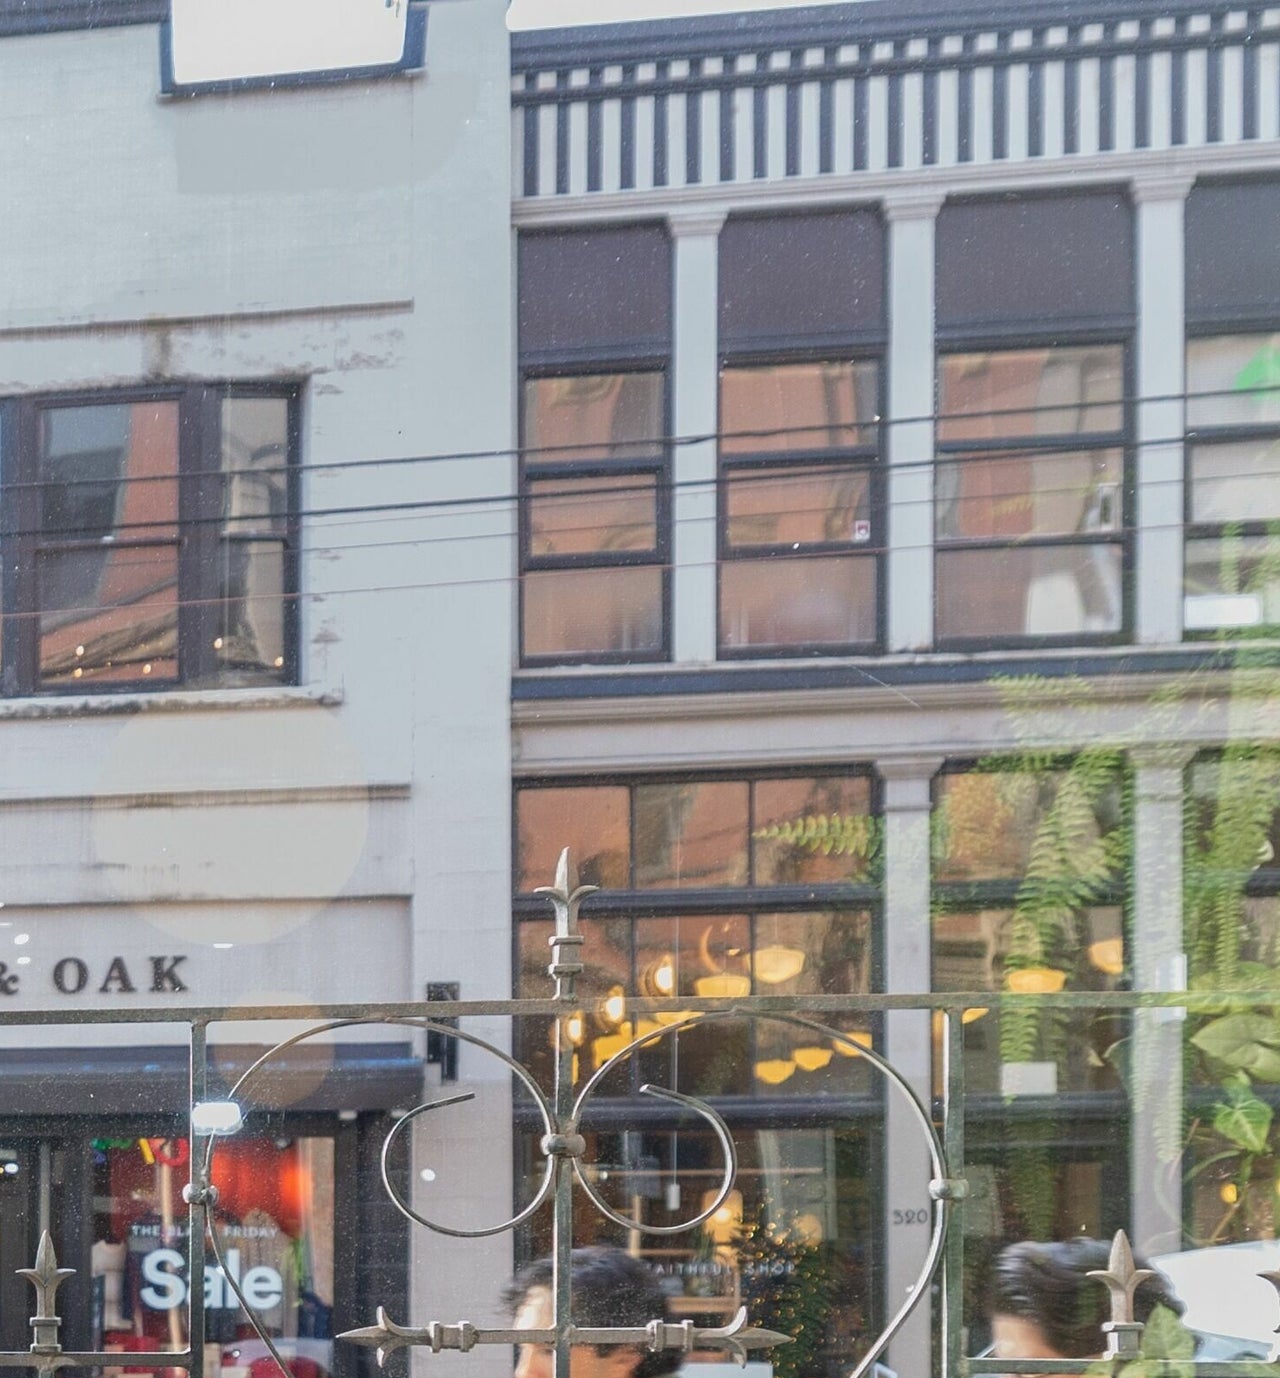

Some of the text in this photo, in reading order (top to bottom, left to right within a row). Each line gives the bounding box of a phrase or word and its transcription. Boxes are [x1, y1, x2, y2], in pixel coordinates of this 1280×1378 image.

[53, 955, 189, 995] OAK
[132, 1224, 161, 1237] THE
[225, 1224, 278, 1238] FRIDAY
[141, 1248, 283, 1310] Sale
